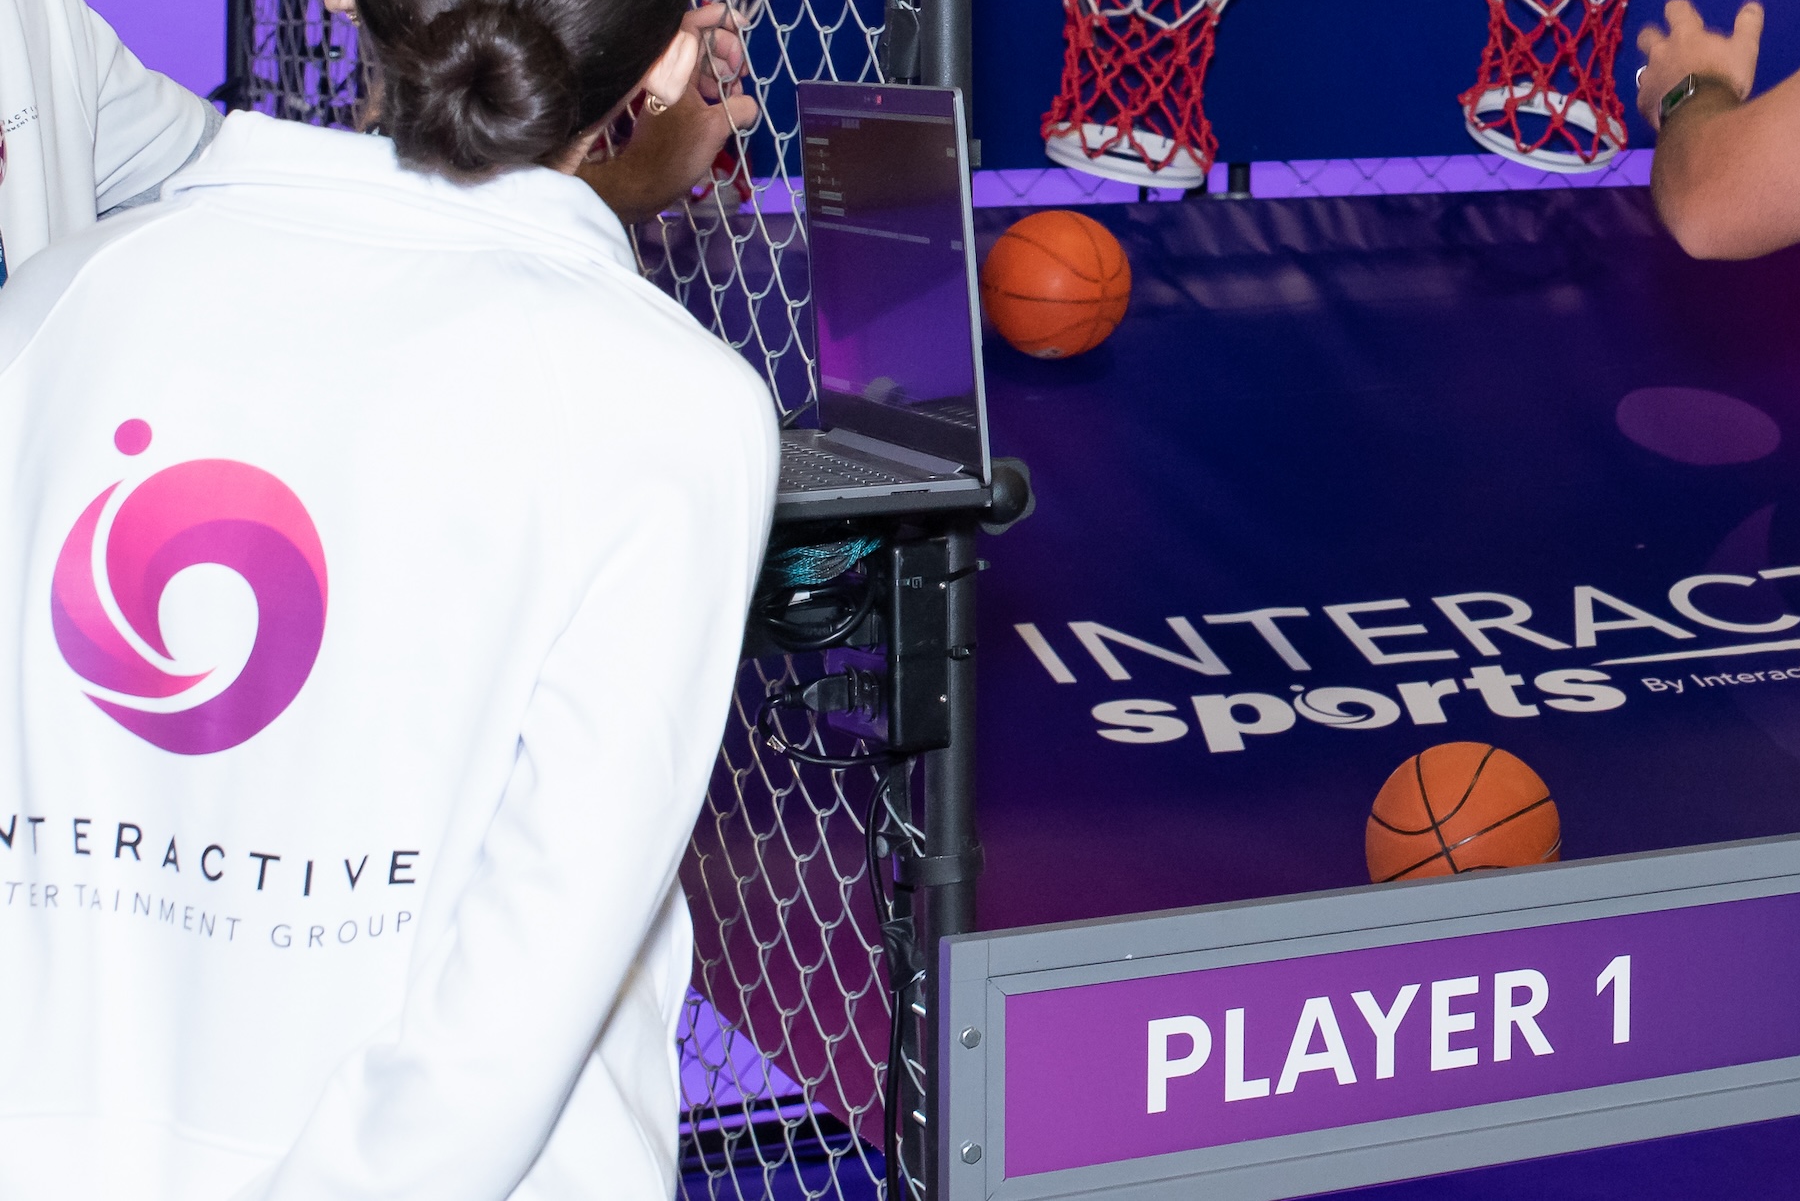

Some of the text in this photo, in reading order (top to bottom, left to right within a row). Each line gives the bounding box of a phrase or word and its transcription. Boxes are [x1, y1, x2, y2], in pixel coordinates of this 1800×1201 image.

[1091, 665, 1627, 753] sports
[1641, 677, 1684, 694] By
[5, 881, 412, 949] TERTAINMENT GROUP
[1147, 955, 1630, 1114] PLAYER 1
